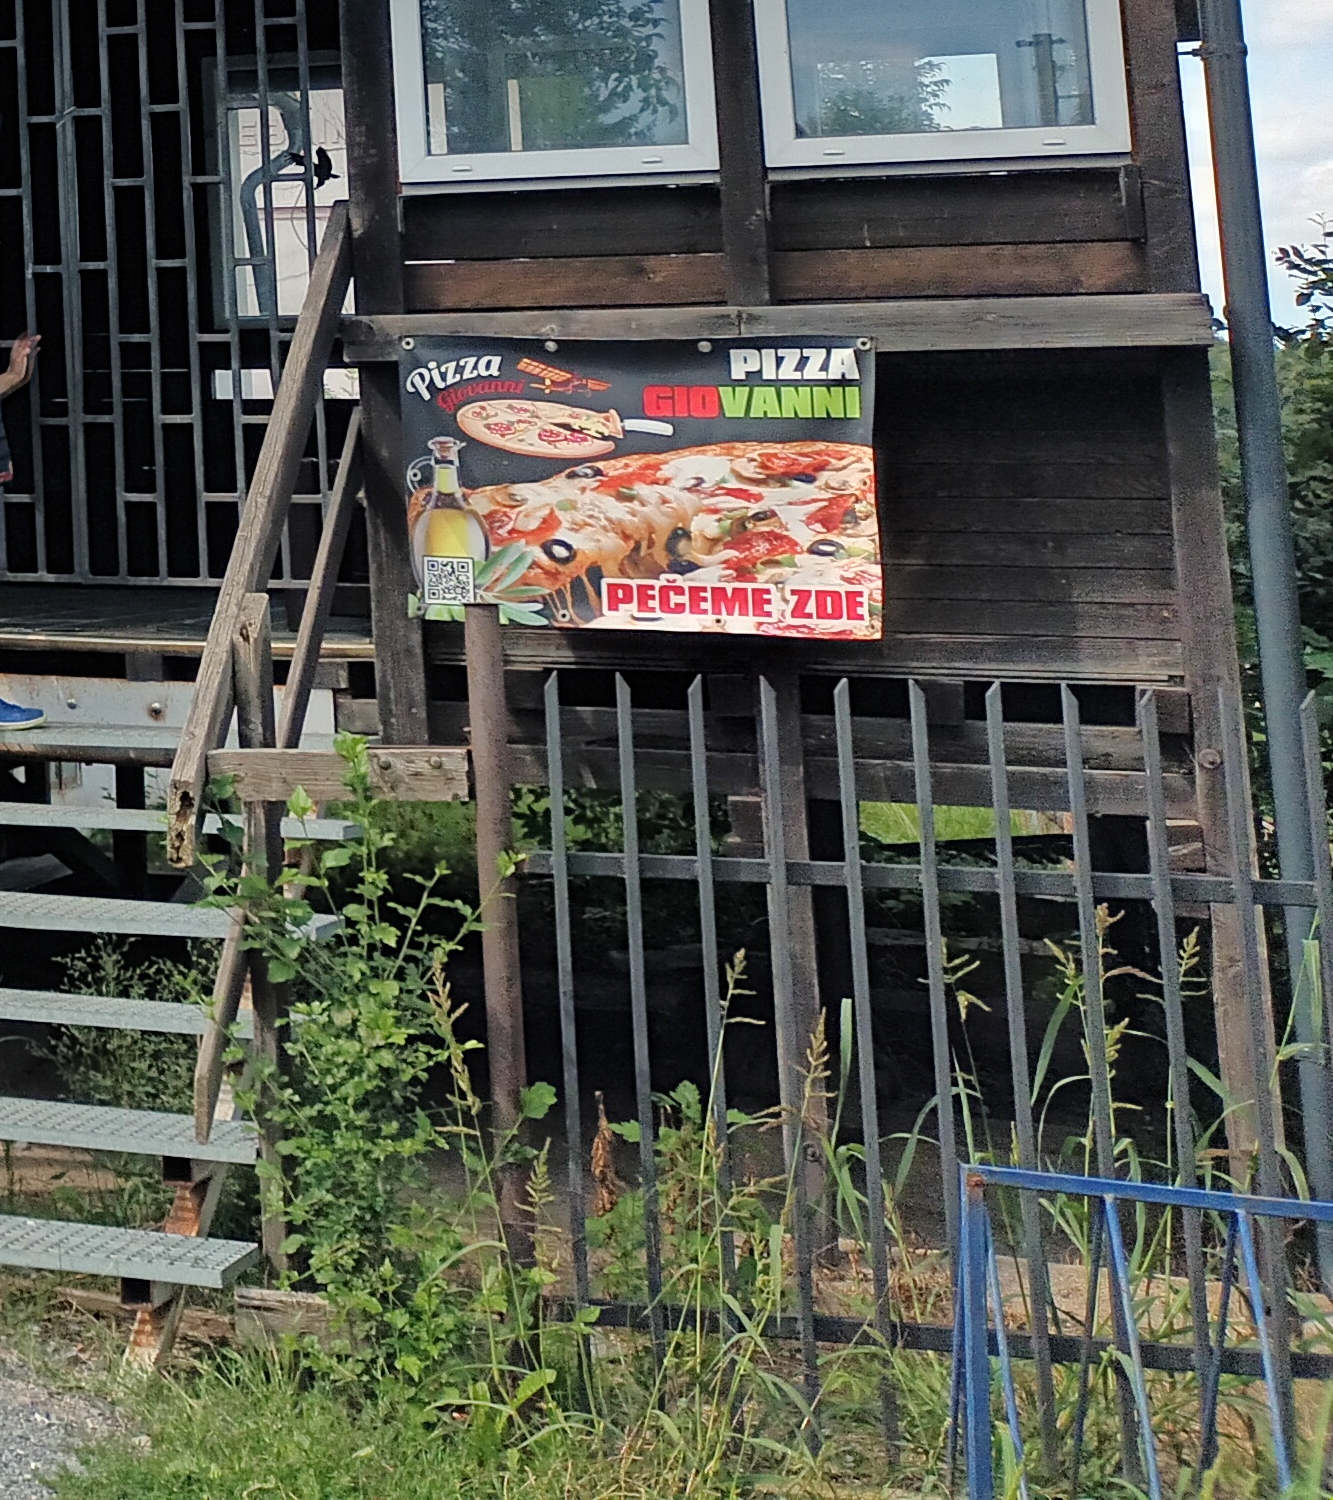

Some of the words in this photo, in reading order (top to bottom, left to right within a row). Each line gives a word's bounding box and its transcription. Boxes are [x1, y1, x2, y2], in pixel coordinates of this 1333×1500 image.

[405, 355, 502, 401] Pizza
[728, 348, 861, 380] PIZZA
[436, 379, 526, 413] Giovanni
[642, 385, 862, 419] GIOVANNI
[605, 578, 774, 618] PEČEME
[789, 588, 866, 621] ZDE
